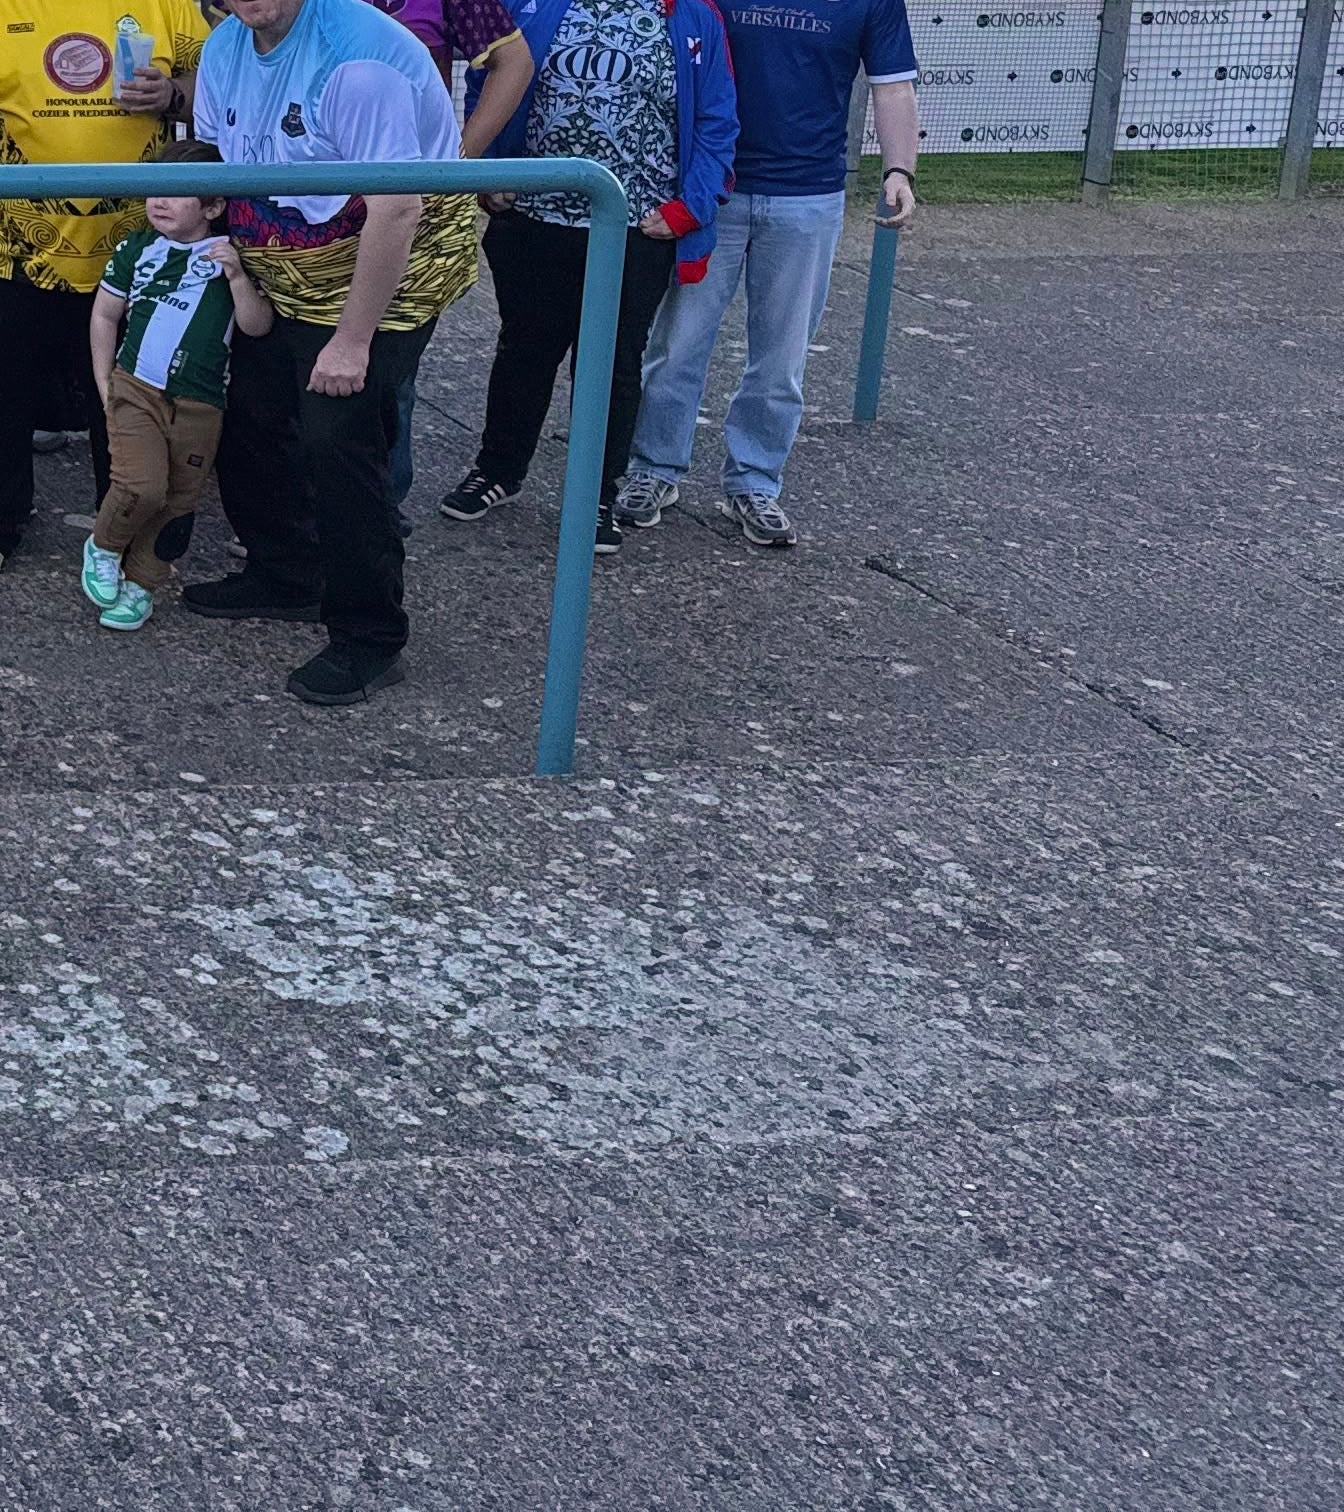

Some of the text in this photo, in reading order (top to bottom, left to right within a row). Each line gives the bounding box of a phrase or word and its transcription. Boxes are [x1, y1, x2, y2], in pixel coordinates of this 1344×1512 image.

[730, 9, 833, 35] VERSAILLES
[990, 11, 1066, 27] SKYBOND
[1154, 9, 1231, 25] SKYBOND
[917, 69, 976, 86] SKYBO
[1228, 64, 1299, 81] KYBOND
[31, 109, 70, 118] COZIER
[975, 124, 1050, 142] SKYBOND
[1139, 122, 1215, 139] SKYBOND
